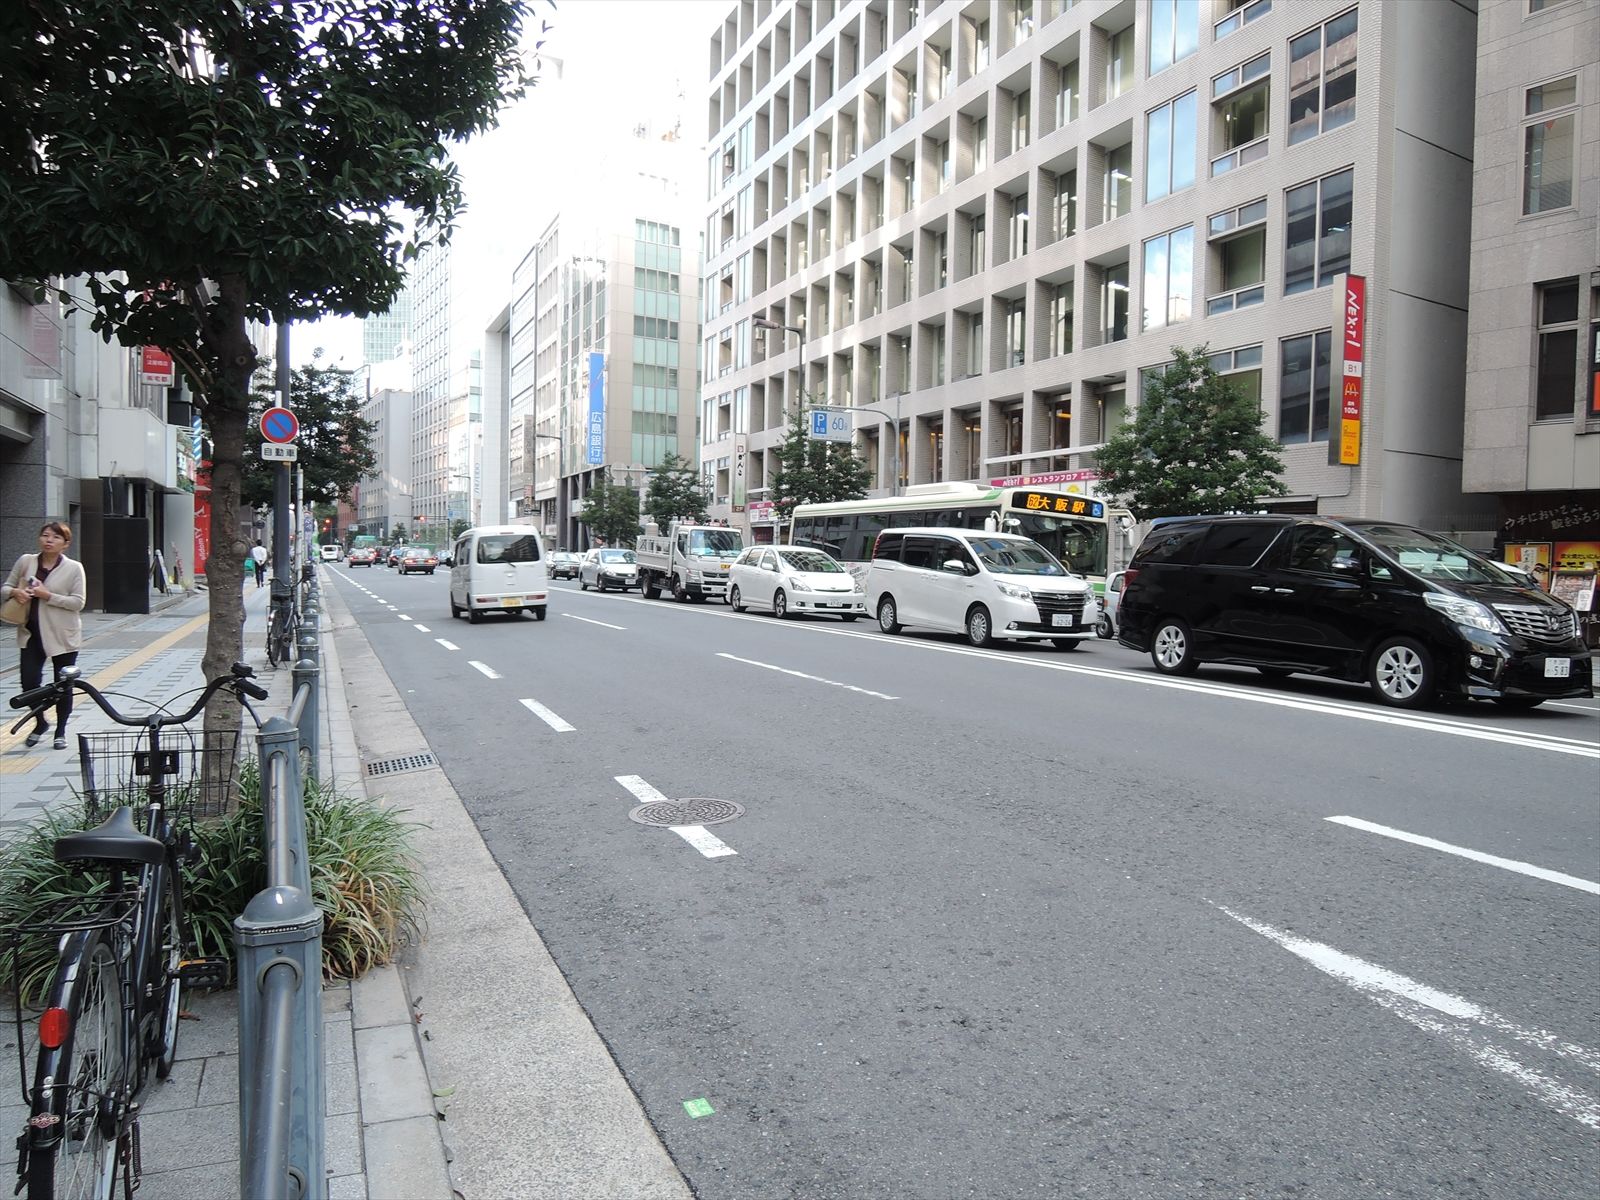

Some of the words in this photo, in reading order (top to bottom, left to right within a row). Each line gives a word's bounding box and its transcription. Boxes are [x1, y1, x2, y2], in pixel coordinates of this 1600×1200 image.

[1347, 364, 1357, 373] B1
[817, 414, 825, 426] P
[591, 411, 601, 457] 広島銀行
[264, 447, 295, 457] 自動車
[1031, 473, 1078, 484] レストランフロア
[1039, 498, 1086, 513] 大阪駅
